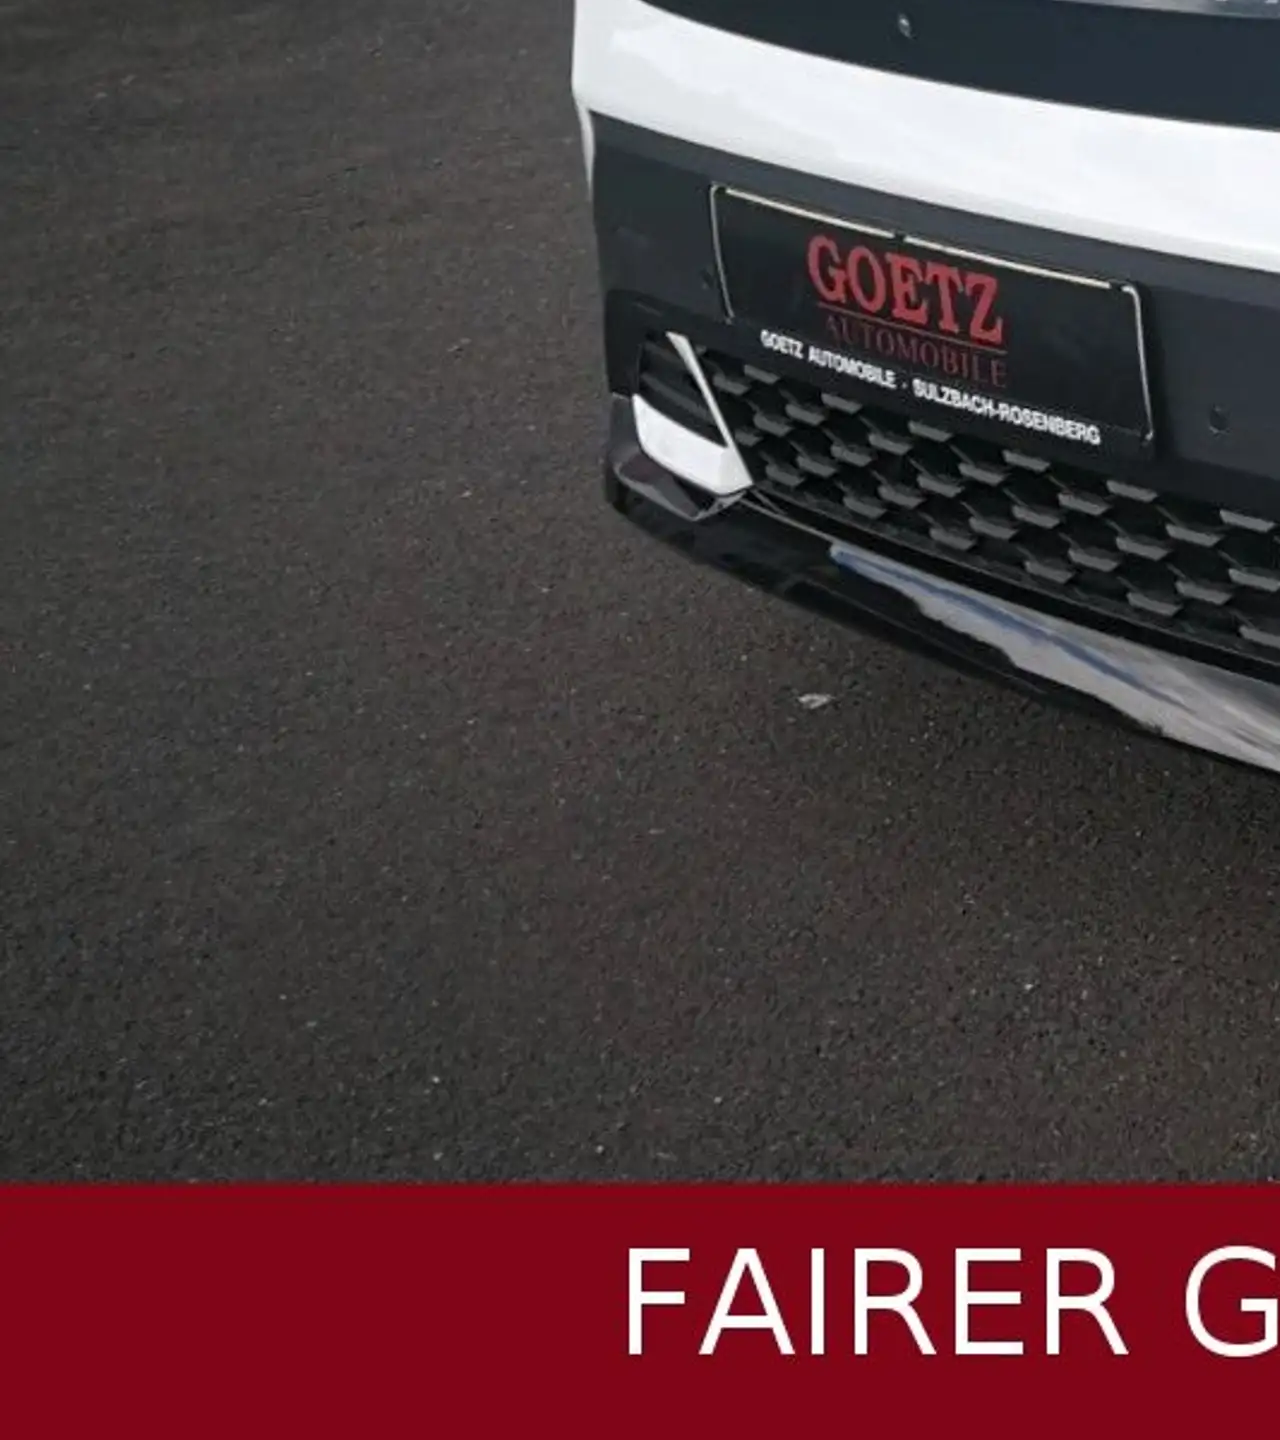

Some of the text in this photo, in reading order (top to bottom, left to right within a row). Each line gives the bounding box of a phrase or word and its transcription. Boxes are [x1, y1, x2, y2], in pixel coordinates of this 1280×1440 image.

[806, 233, 1004, 346] GOETZ
[760, 329, 804, 359] GOETZ
[808, 346, 897, 389] AUTOMOBILE
[912, 378, 1101, 446] SULZBACH-ROSENBERG
[824, 313, 1007, 389] AUTOMOBILE
